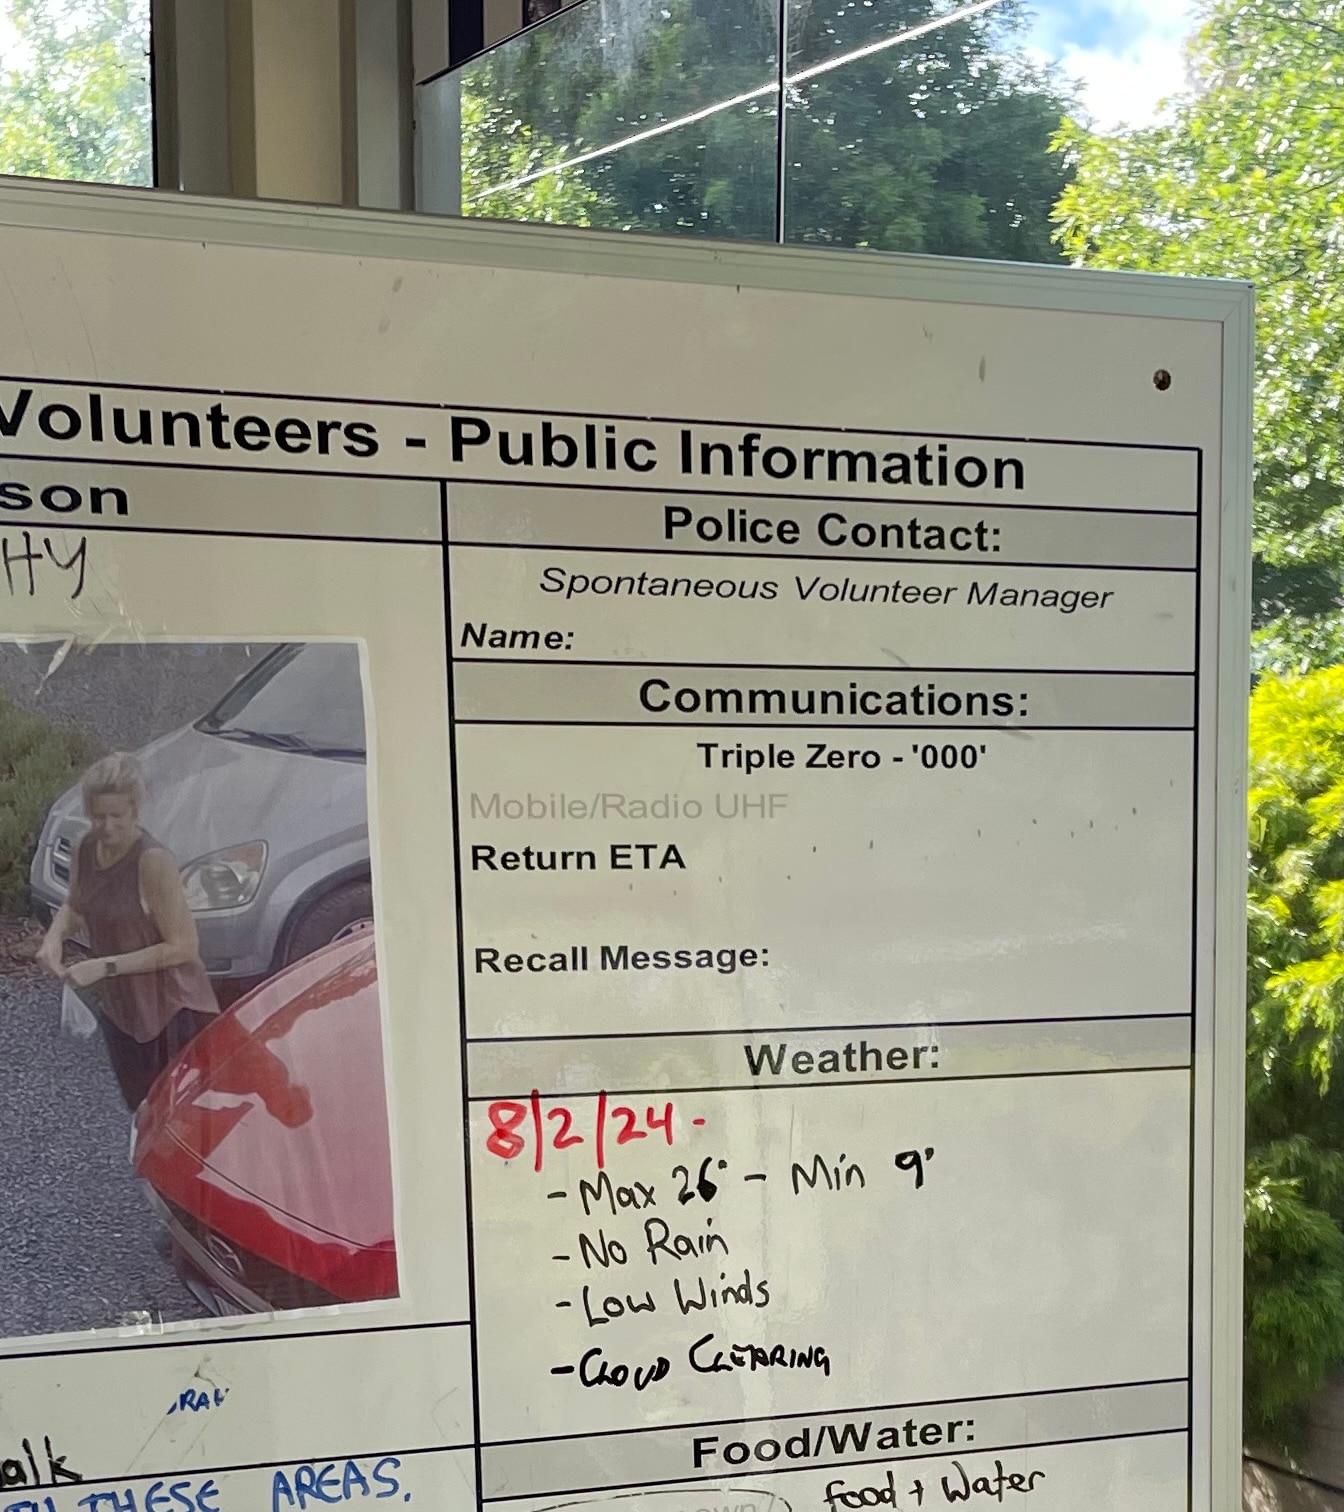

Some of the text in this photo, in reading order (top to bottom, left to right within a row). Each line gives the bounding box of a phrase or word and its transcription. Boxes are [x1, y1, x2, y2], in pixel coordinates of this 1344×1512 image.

[451, 416, 659, 474] Public
[679, 428, 1027, 491] Information
[663, 505, 1003, 554] Police Contact:
[540, 566, 1114, 614] Spontaneous Volunteer Manager
[460, 624, 575, 652] Name:
[638, 678, 1030, 718] Communications:
[697, 742, 795, 773] Triple
[805, 744, 882, 770] Zero
[468, 793, 790, 821] Mobile/Radio UHF
[470, 843, 686, 872] Return ETA
[474, 944, 771, 977] Recall Message:
[745, 1042, 940, 1076] Weather:
[791, 1154, 866, 1197] Min
[647, 1219, 729, 1265] Rain
[674, 1275, 770, 1314] Winds
[692, 1418, 977, 1469] Food/Water:
